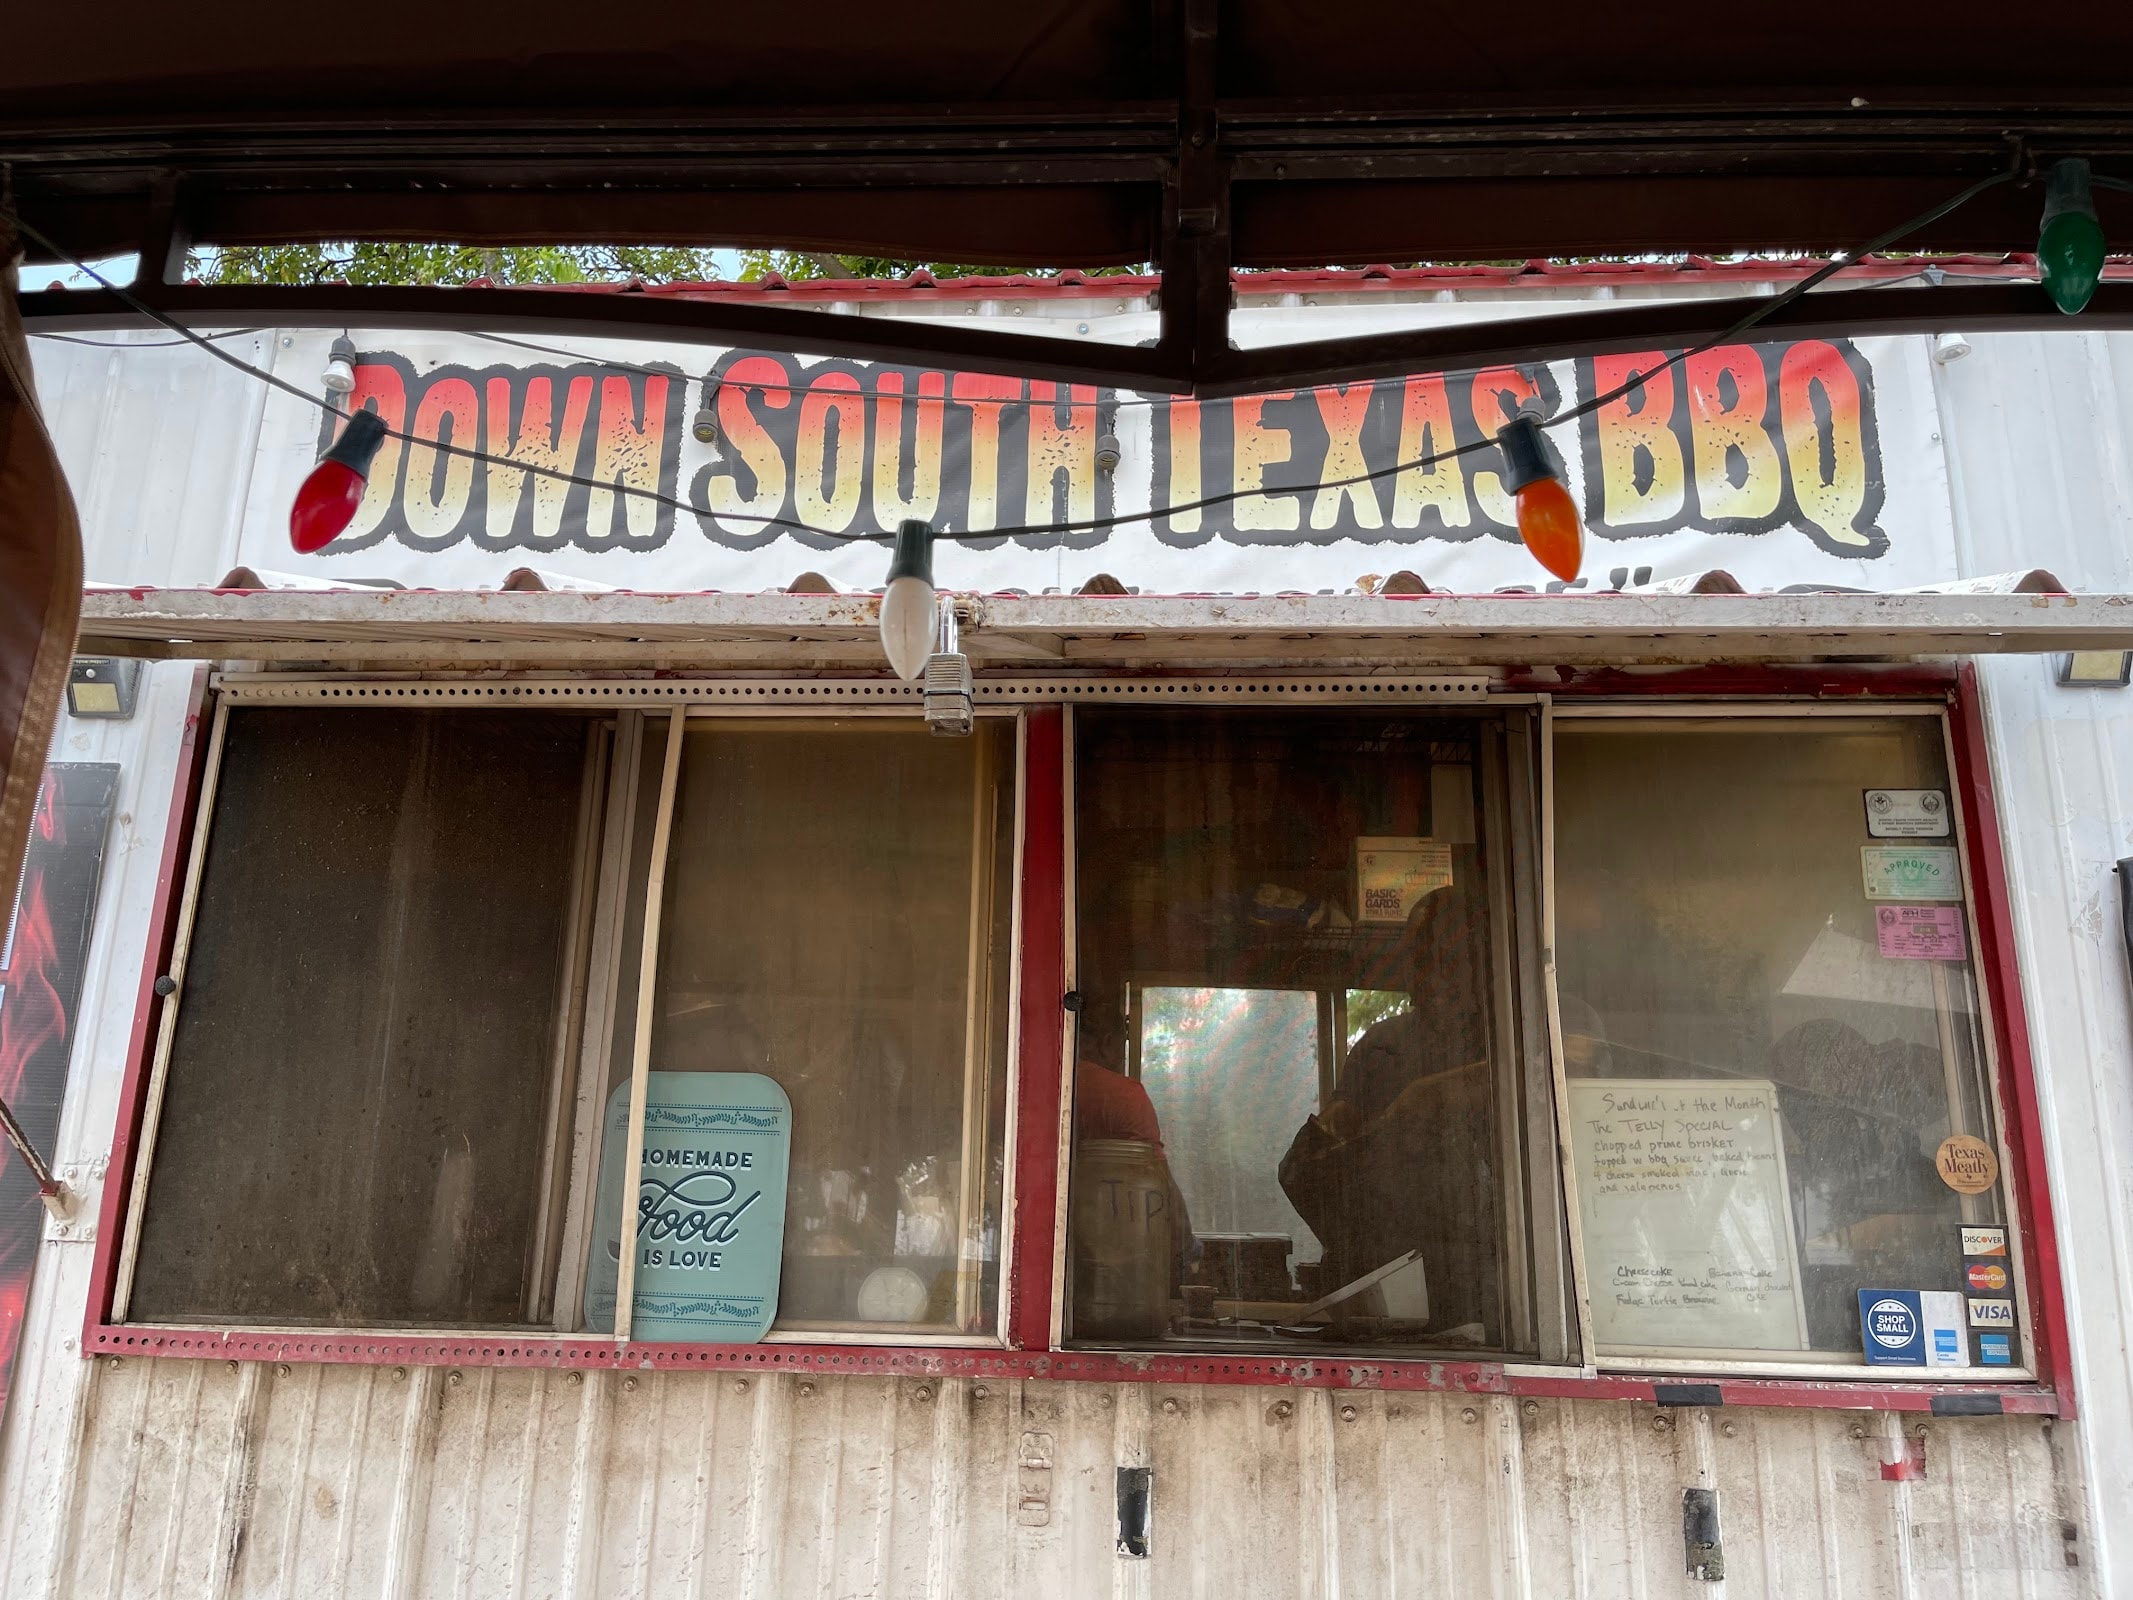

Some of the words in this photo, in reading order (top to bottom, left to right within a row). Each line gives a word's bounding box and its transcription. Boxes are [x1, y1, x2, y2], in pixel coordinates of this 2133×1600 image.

[328, 360, 674, 544] DOWN
[704, 354, 1097, 540] SOUTH
[1166, 366, 1540, 536] TEXAS
[1593, 339, 1872, 546] BBQ
[1884, 859, 1940, 877] APPROVED
[1366, 888, 1396, 899] BASIC
[1366, 899, 1401, 908] GARDS
[1693, 1097, 1717, 1112] the
[1725, 1096, 1766, 1111] Month
[1587, 1120, 1612, 1134] The
[1618, 1119, 1664, 1140] TELLY
[1594, 1140, 1642, 1154] chopped
[1650, 1141, 1681, 1153] prime
[1946, 1143, 1985, 1159] Texas
[1963, 1235, 2003, 1244] DISCOVER
[643, 1249, 663, 1269] IS
[668, 1251, 722, 1271] LOVE
[1968, 1272, 2006, 1282] MasterCard
[1877, 1314, 1906, 1324] SHOP
[1974, 1306, 2011, 1320] VISA
[1876, 1323, 1909, 1333] SMALL
